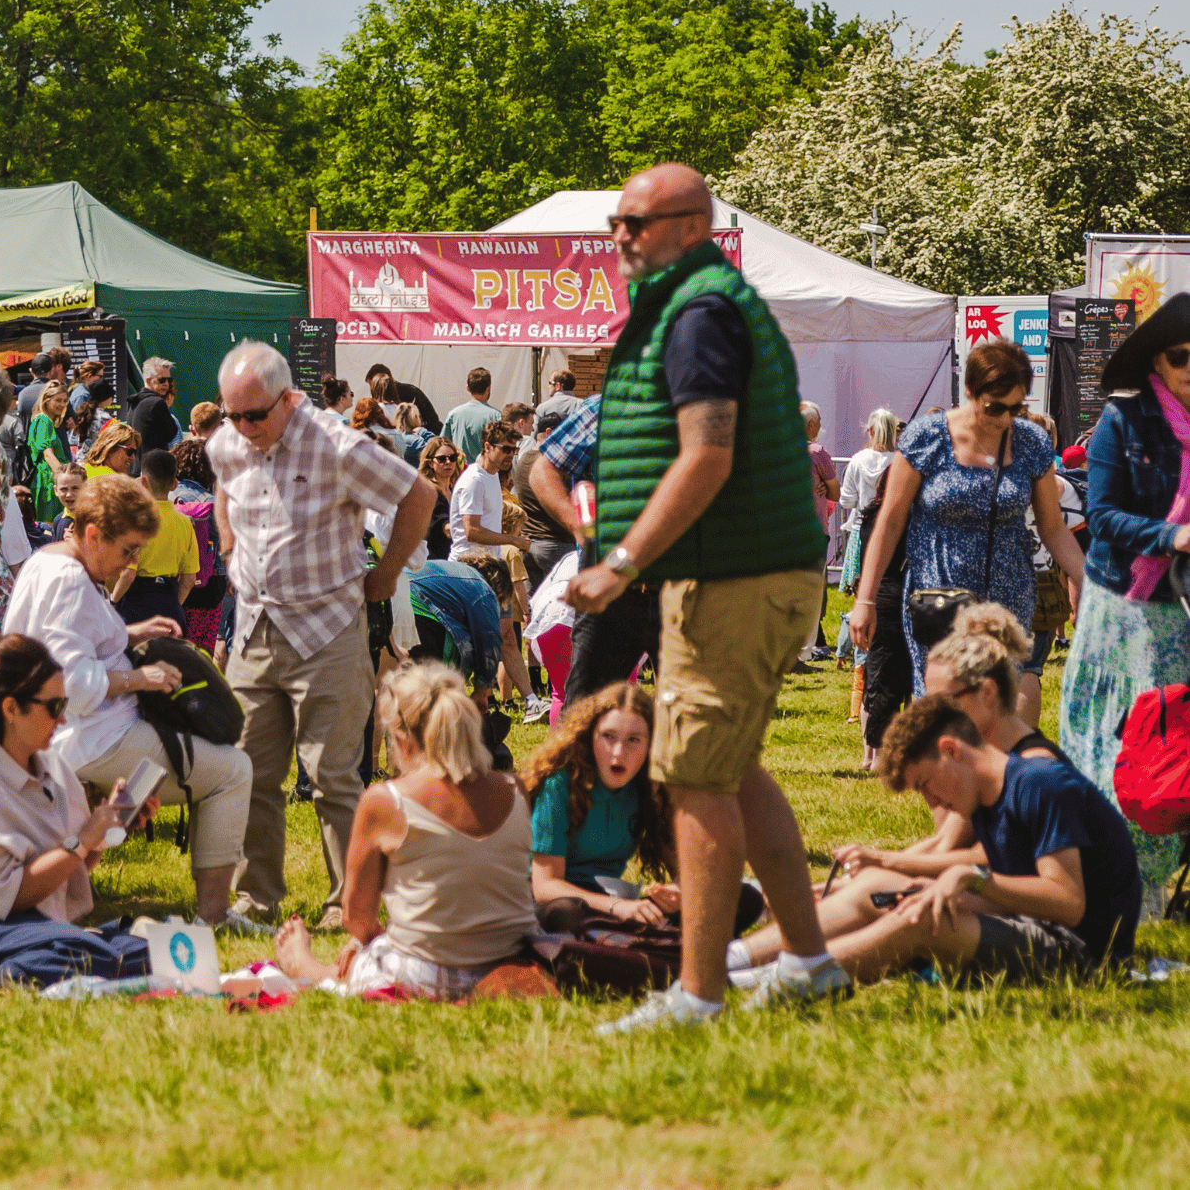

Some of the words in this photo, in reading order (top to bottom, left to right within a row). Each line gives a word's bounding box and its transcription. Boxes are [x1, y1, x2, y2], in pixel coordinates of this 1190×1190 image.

[317, 239, 421, 256] MARGHERITA
[458, 240, 539, 256] HAWAIIAN
[571, 240, 621, 257] PEPP
[471, 267, 617, 315] PITSA
[62, 291, 88, 307] food
[967, 307, 981, 317] AR
[1084, 303, 1109, 317] Crêpes
[336, 319, 381, 338] OCED
[432, 321, 521, 338] MADARCH
[527, 321, 609, 339] GARLLEG
[967, 319, 987, 329] LOG
[1022, 335, 1042, 347] AND
